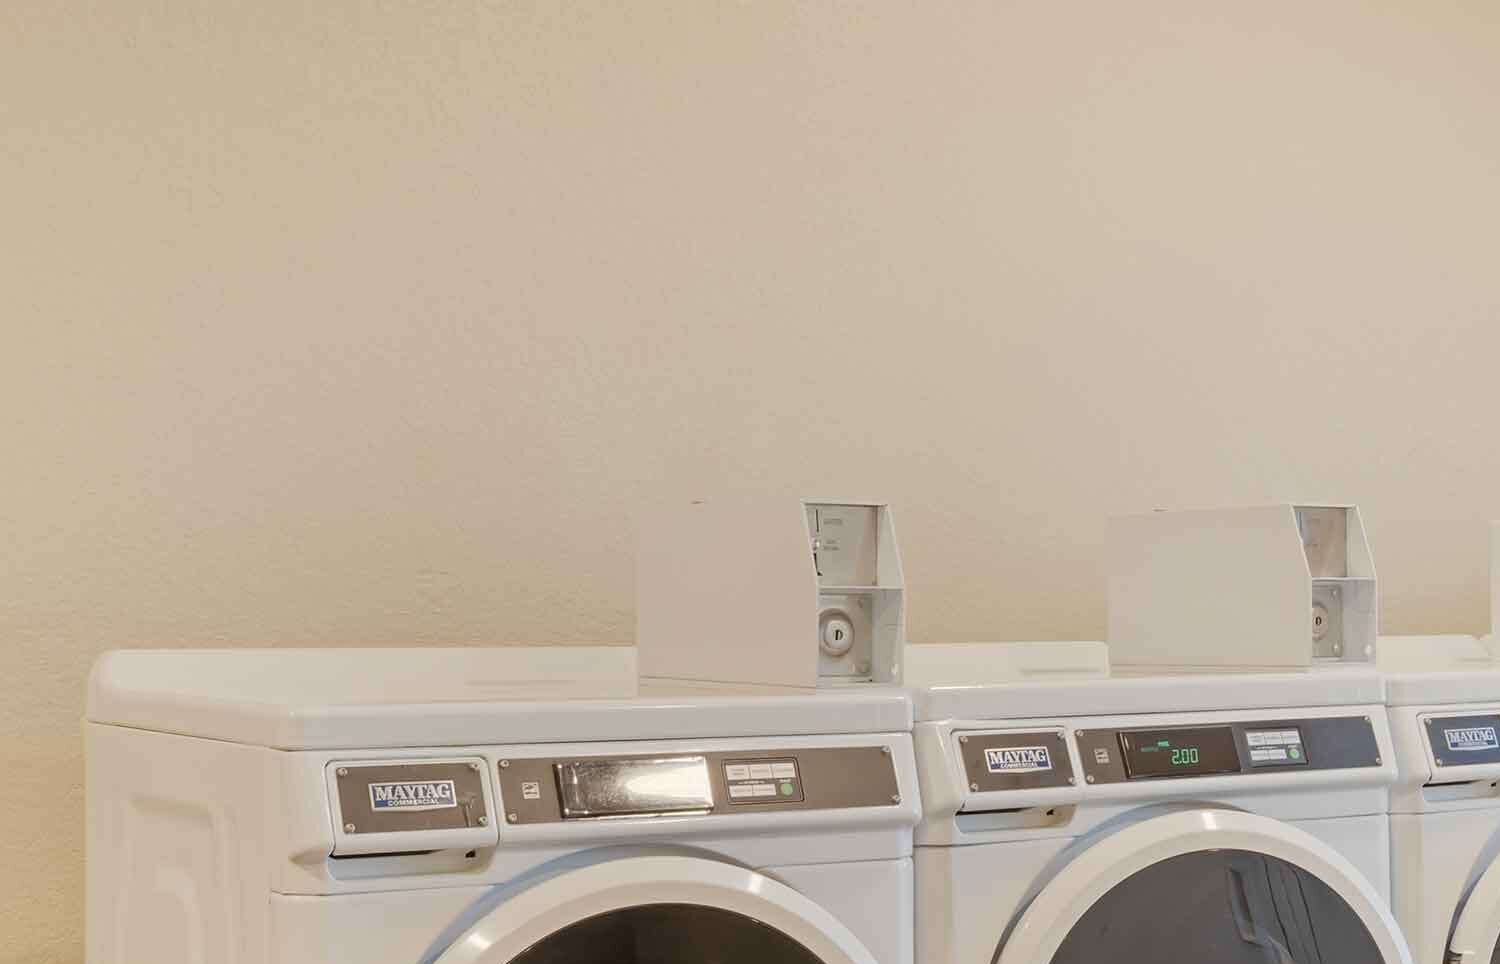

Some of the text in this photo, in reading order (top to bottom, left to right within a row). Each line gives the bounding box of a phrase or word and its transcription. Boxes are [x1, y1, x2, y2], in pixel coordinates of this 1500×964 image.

[1448, 730, 1494, 743] MAYTAG
[988, 750, 1047, 764] MAYTAG
[1171, 748, 1200, 765] 2.00
[374, 783, 452, 801] MAYTAG
